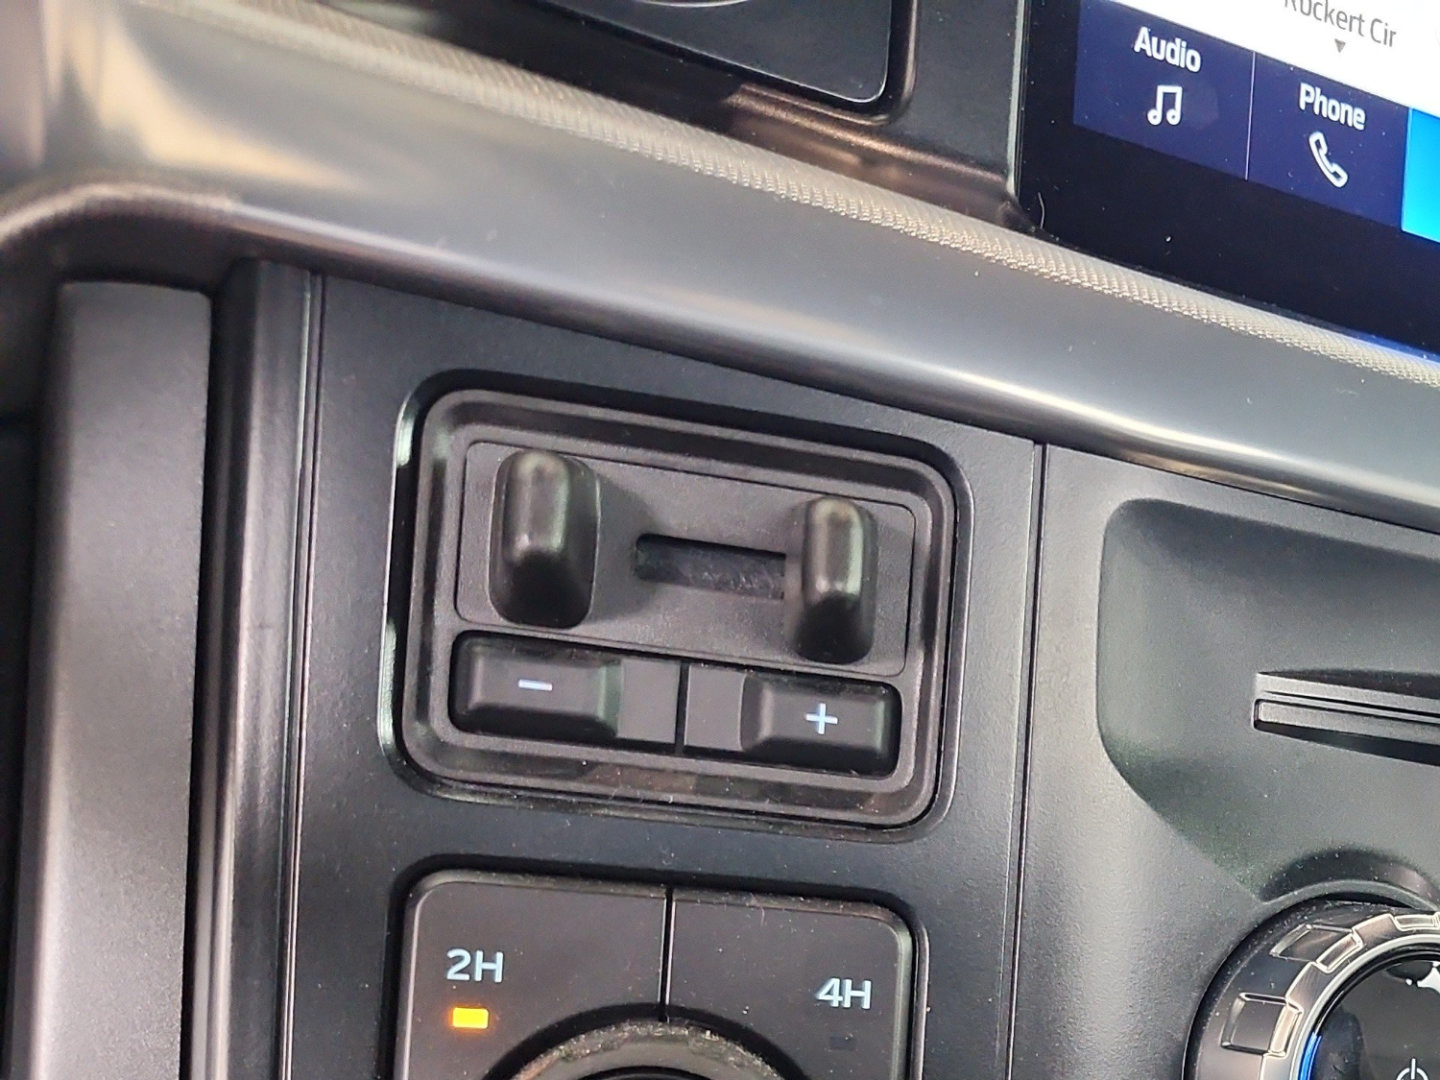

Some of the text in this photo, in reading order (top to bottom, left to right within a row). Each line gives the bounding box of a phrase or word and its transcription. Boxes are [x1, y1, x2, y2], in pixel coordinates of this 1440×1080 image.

[1134, 26, 1201, 73] Audio
[1370, 18, 1396, 47] Cir
[1299, 82, 1366, 131] Phone
[446, 948, 504, 984] 2H
[816, 977, 872, 1010] 4H
